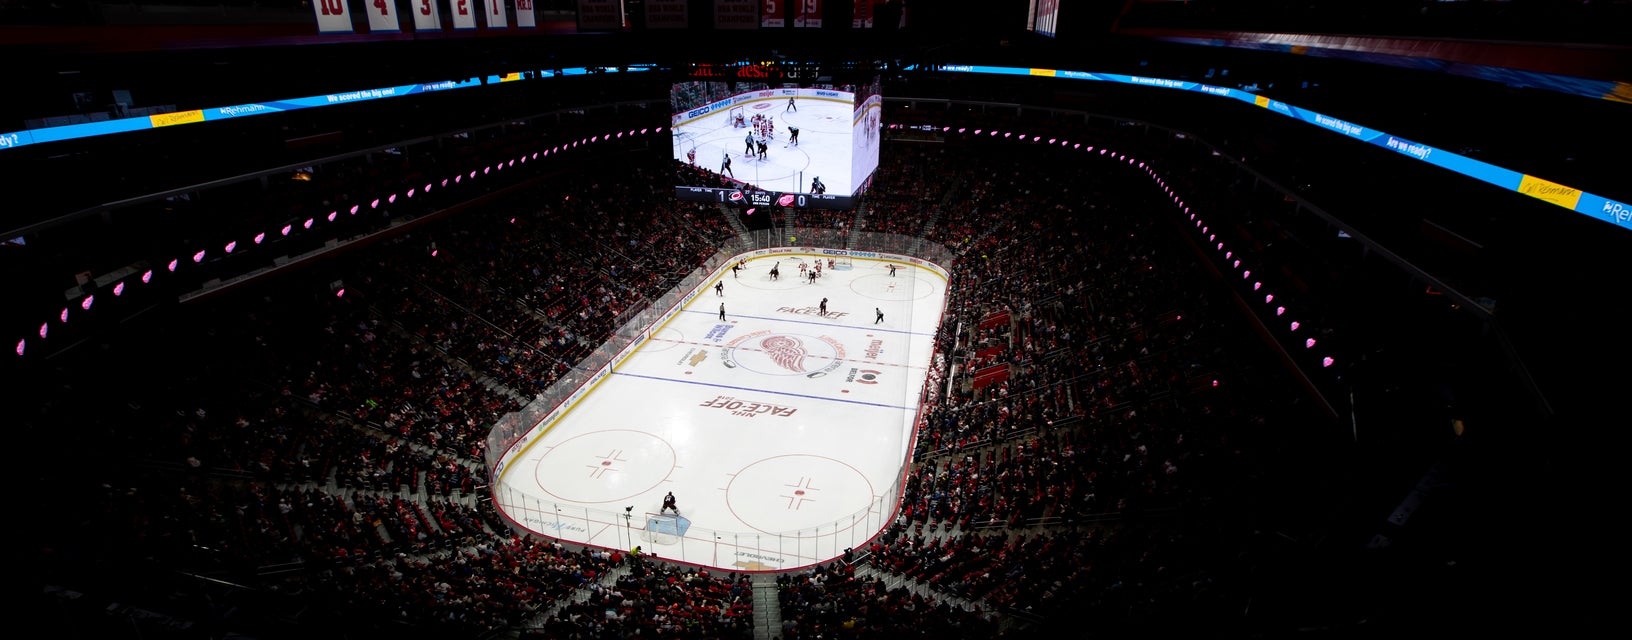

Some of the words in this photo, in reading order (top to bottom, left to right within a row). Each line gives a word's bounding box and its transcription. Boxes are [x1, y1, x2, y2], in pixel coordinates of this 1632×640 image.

[327, 94, 338, 103] We
[340, 91, 360, 100] scored
[361, 90, 371, 98] the
[372, 89, 382, 98] big
[382, 88, 395, 96] one!
[226, 105, 265, 117] Rehmann
[688, 106, 710, 118] GEICO
[1386, 136, 1398, 148] Are
[1398, 141, 1408, 151] we
[1408, 145, 1432, 160] ready?
[718, 190, 724, 202] 1
[751, 194, 770, 202] 15:40
[798, 195, 806, 207] 0
[865, 339, 885, 360] meijer
[699, 398, 798, 418] FACE-OFF
[732, 410, 757, 418] NHL
[734, 551, 785, 564] CHEVROLET
